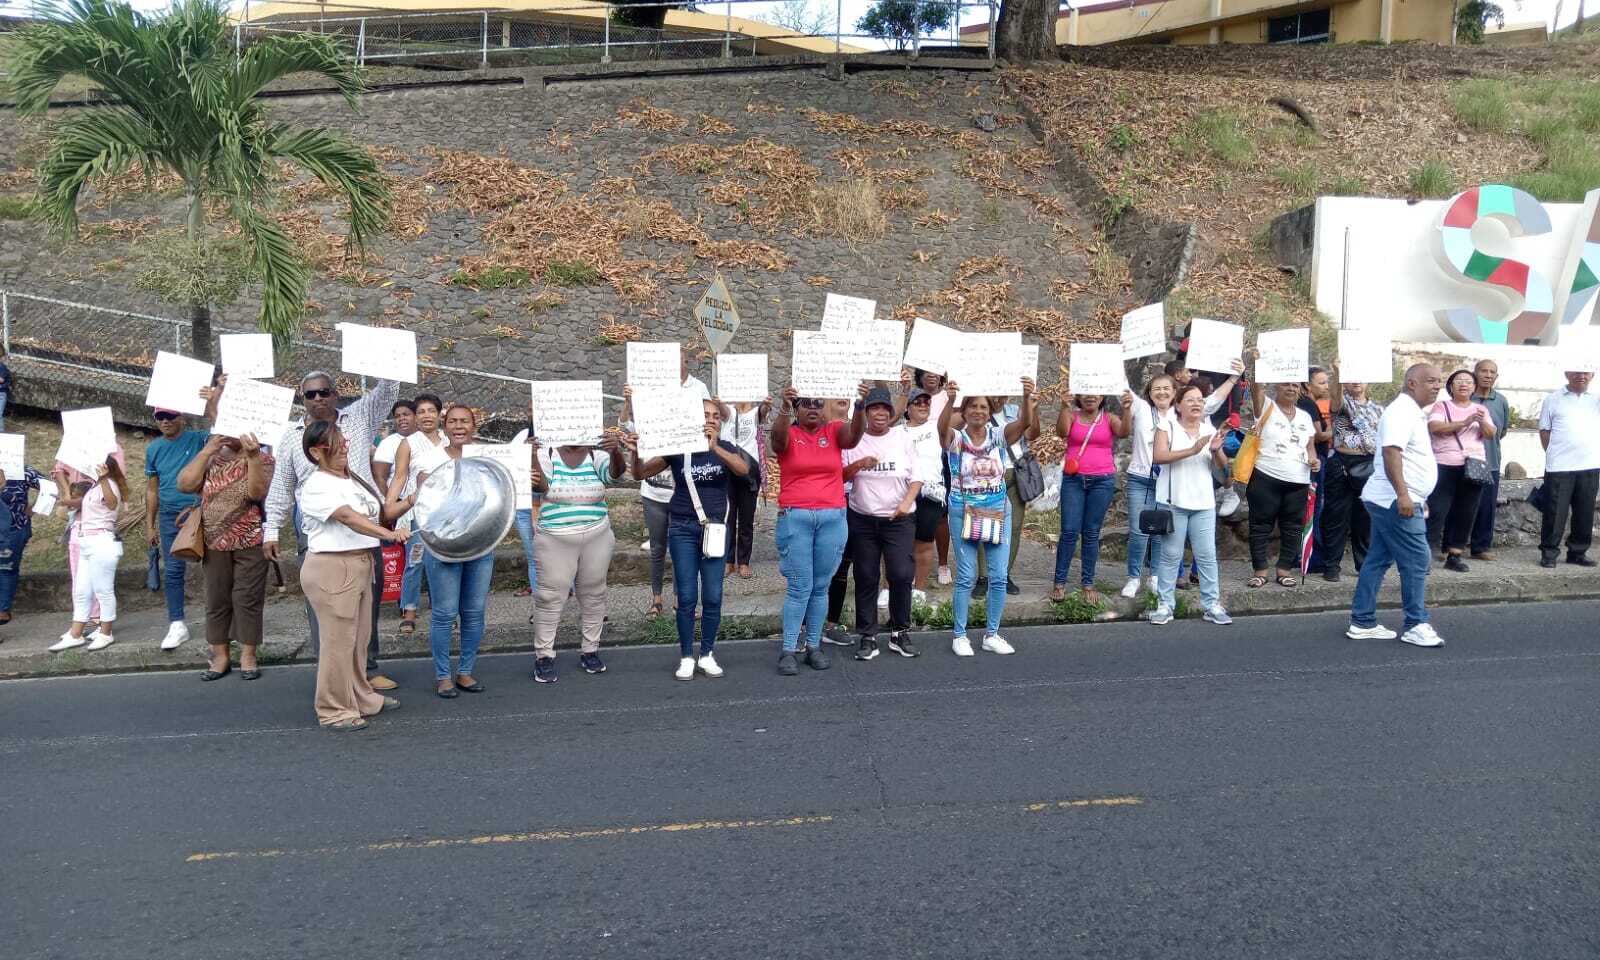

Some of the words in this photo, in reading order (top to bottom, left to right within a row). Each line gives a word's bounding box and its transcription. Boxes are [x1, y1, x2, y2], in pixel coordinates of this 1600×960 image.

[705, 296, 732, 311] REDUZCA
[714, 310, 722, 319] LA
[700, 316, 734, 333] VELOCIDAD
